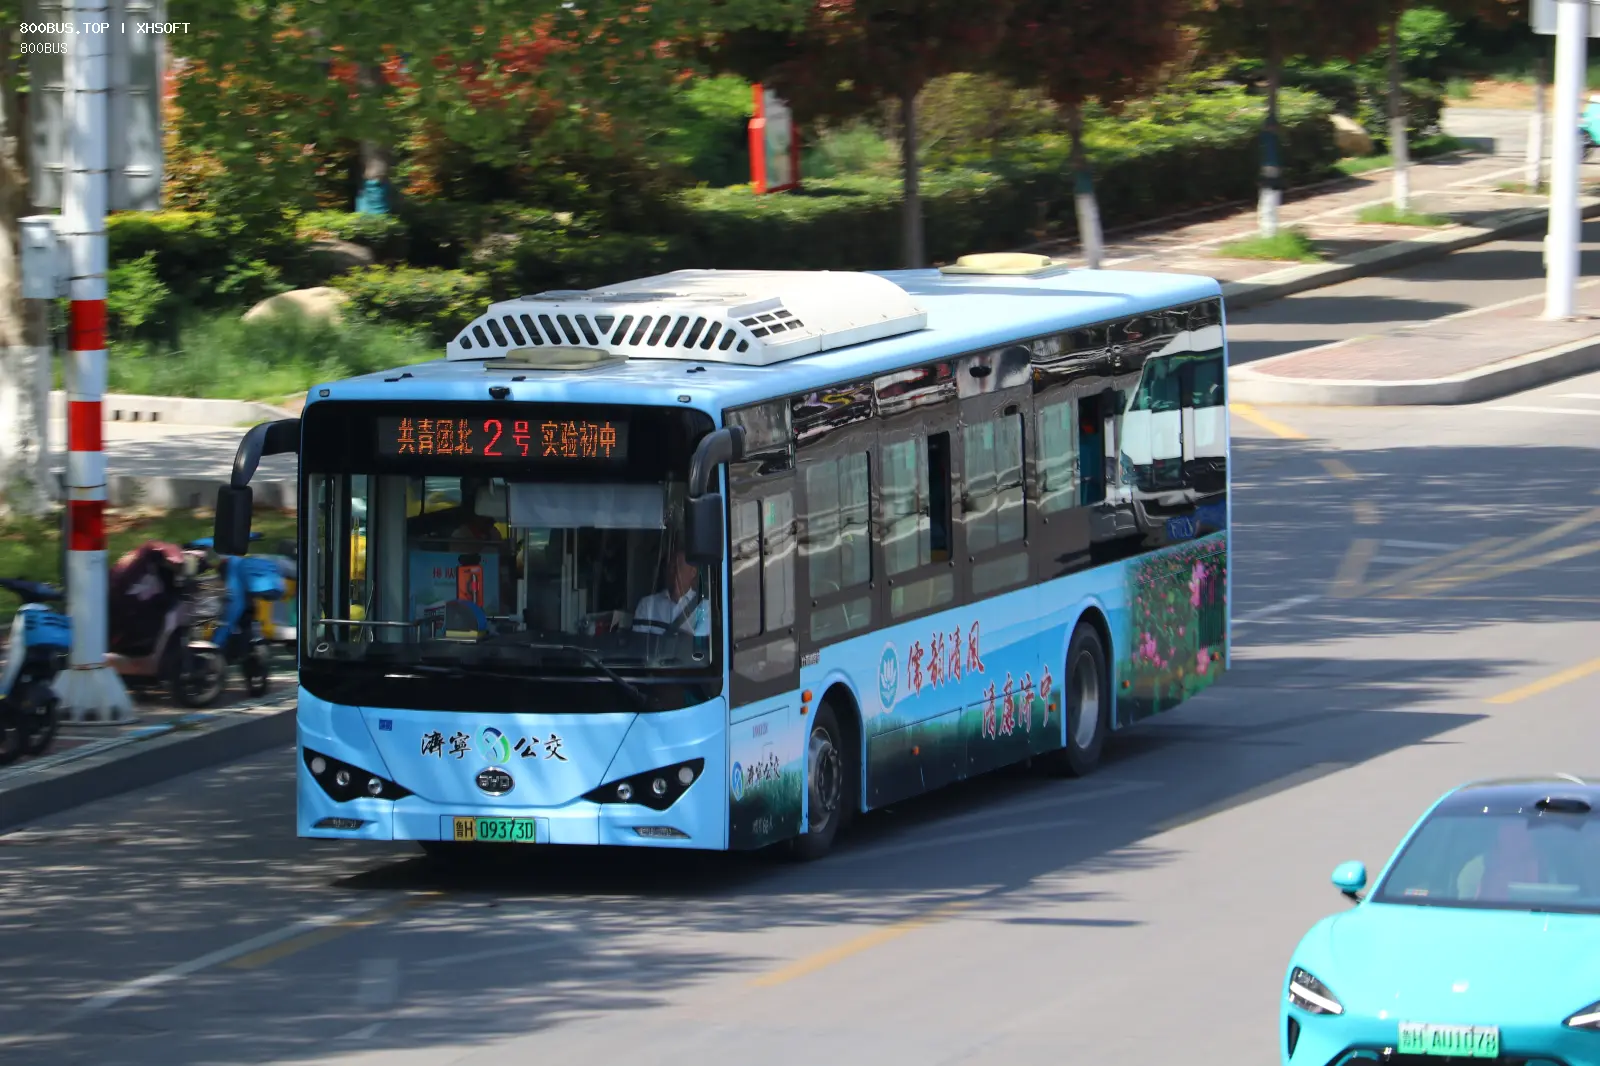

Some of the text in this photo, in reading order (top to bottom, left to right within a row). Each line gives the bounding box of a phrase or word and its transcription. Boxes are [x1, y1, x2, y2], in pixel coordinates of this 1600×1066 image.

[397, 417, 474, 455] 共青团北
[541, 420, 617, 458] 实验初中
[513, 734, 568, 761] 公交
[479, 774, 511, 789] BYD
[480, 820, 534, 840] 09373D
